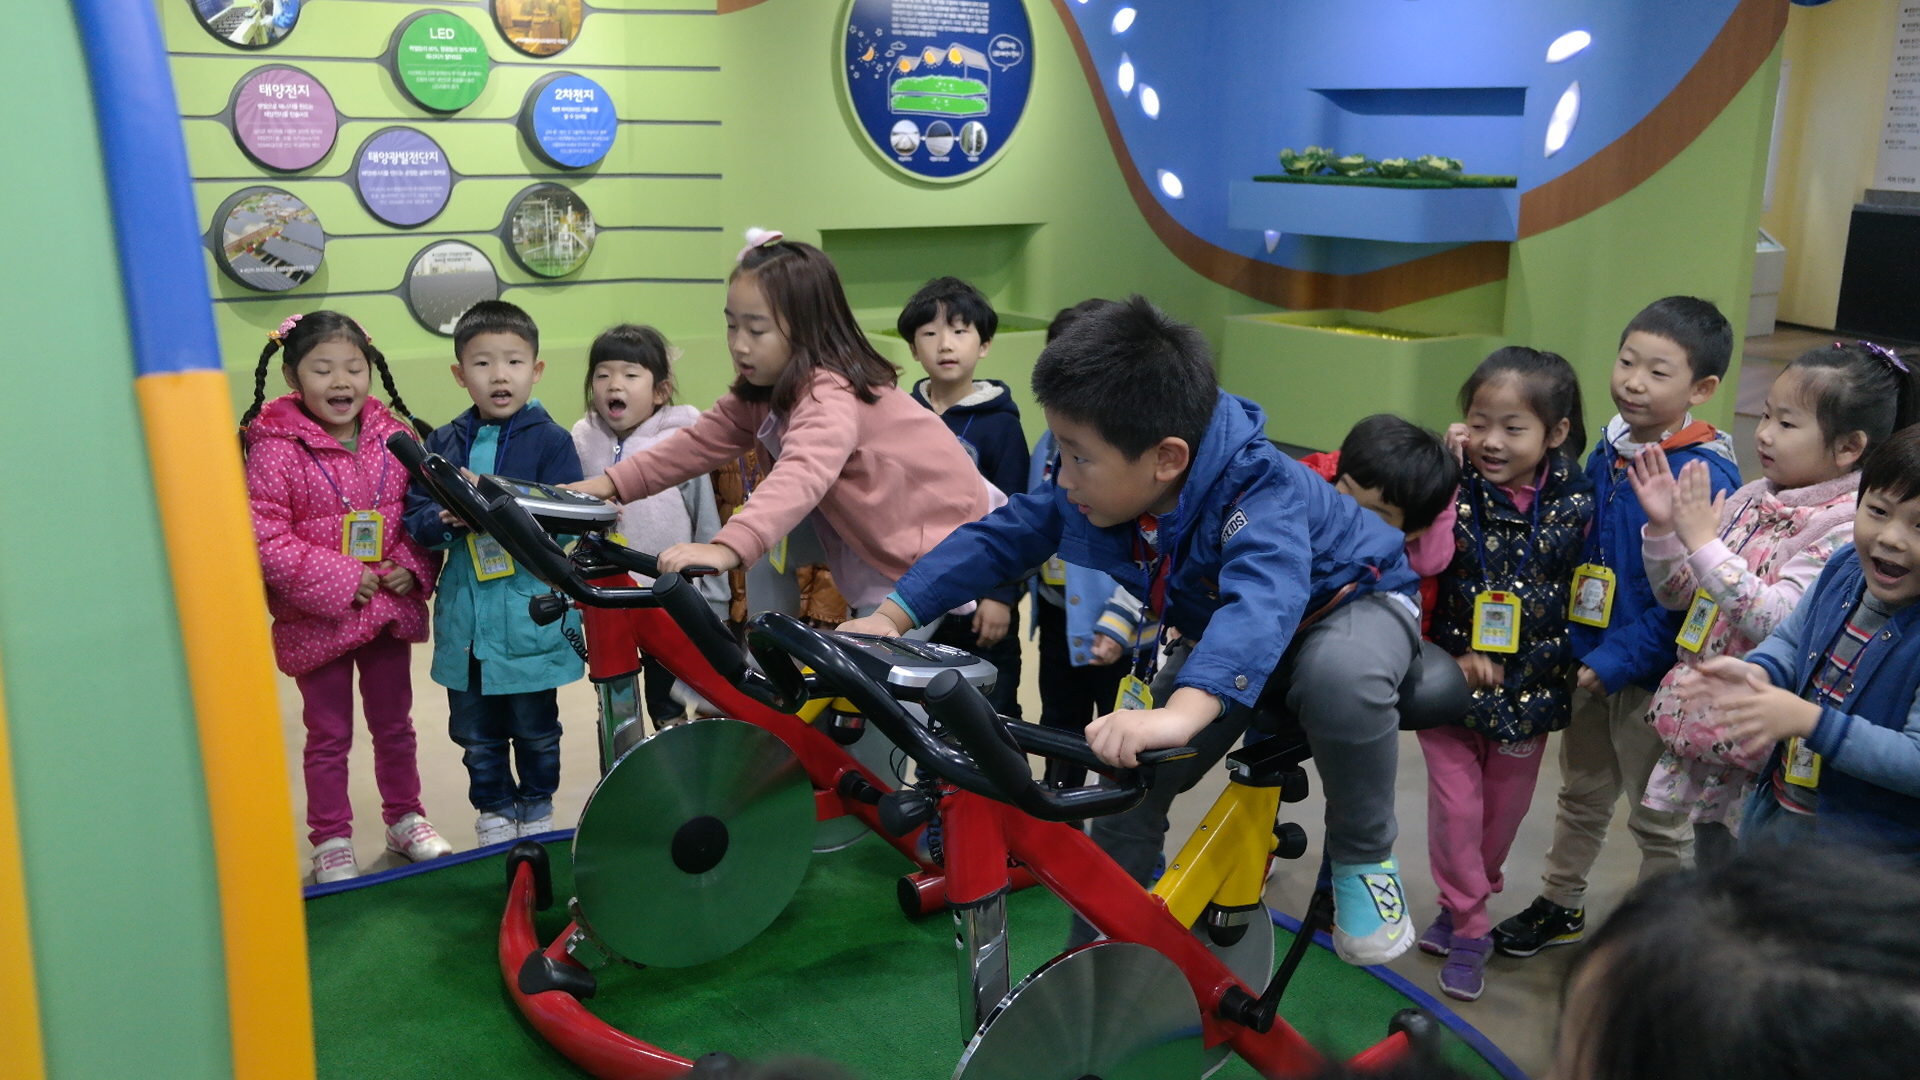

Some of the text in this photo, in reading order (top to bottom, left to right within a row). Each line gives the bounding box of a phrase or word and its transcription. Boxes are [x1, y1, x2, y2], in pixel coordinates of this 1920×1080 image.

[429, 28, 455, 39] LED
[258, 83, 310, 99] 태양전지
[555, 88, 594, 103] 2차전지
[368, 151, 439, 165] 태양광발전단지
